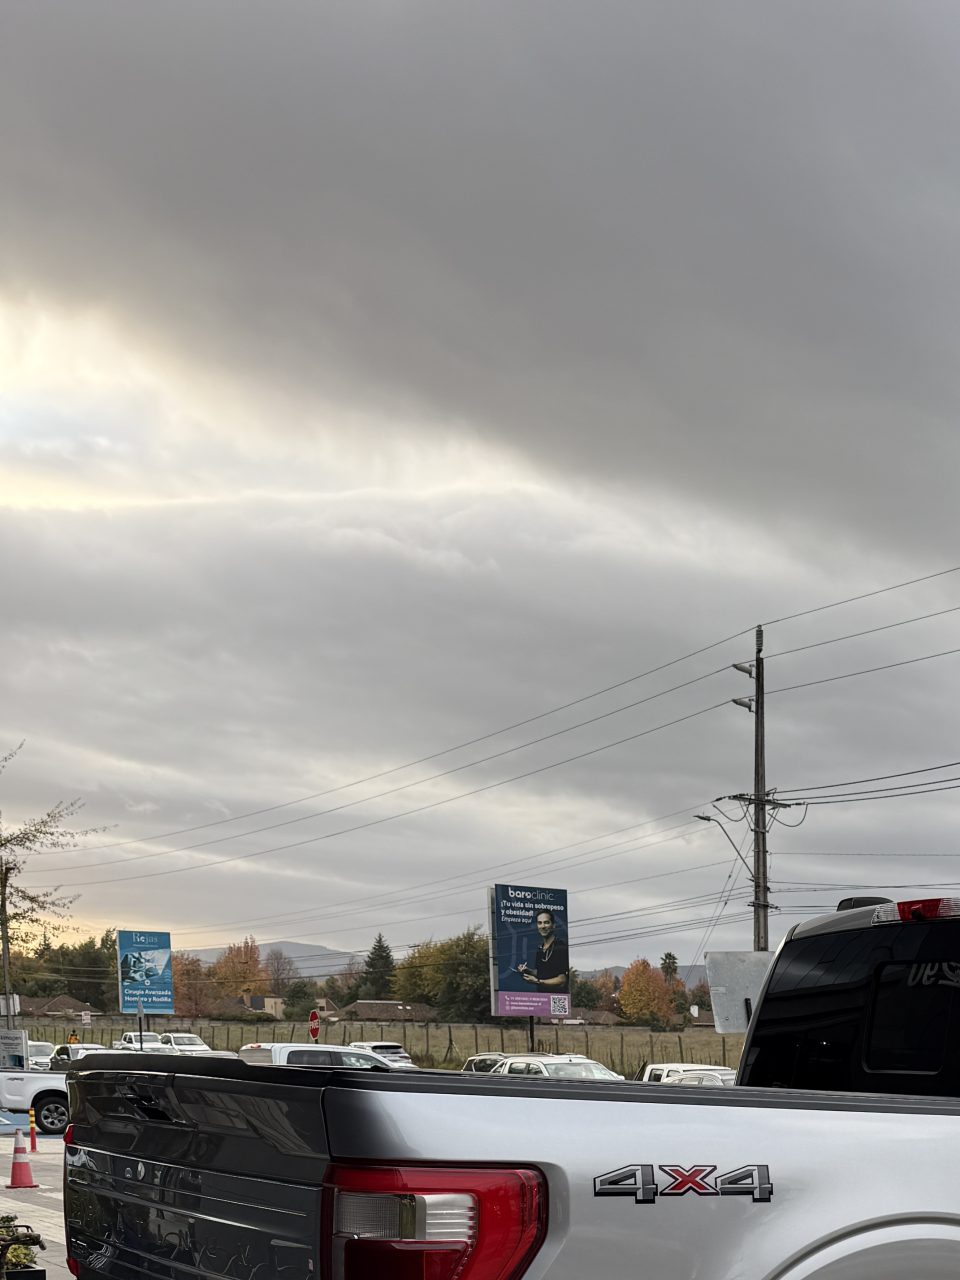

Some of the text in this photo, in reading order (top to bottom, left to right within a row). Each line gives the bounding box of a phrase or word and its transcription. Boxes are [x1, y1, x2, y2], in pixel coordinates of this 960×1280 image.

[508, 886, 555, 900] baroclinic
[511, 900, 524, 908] vida
[534, 902, 565, 911] sobrepeso
